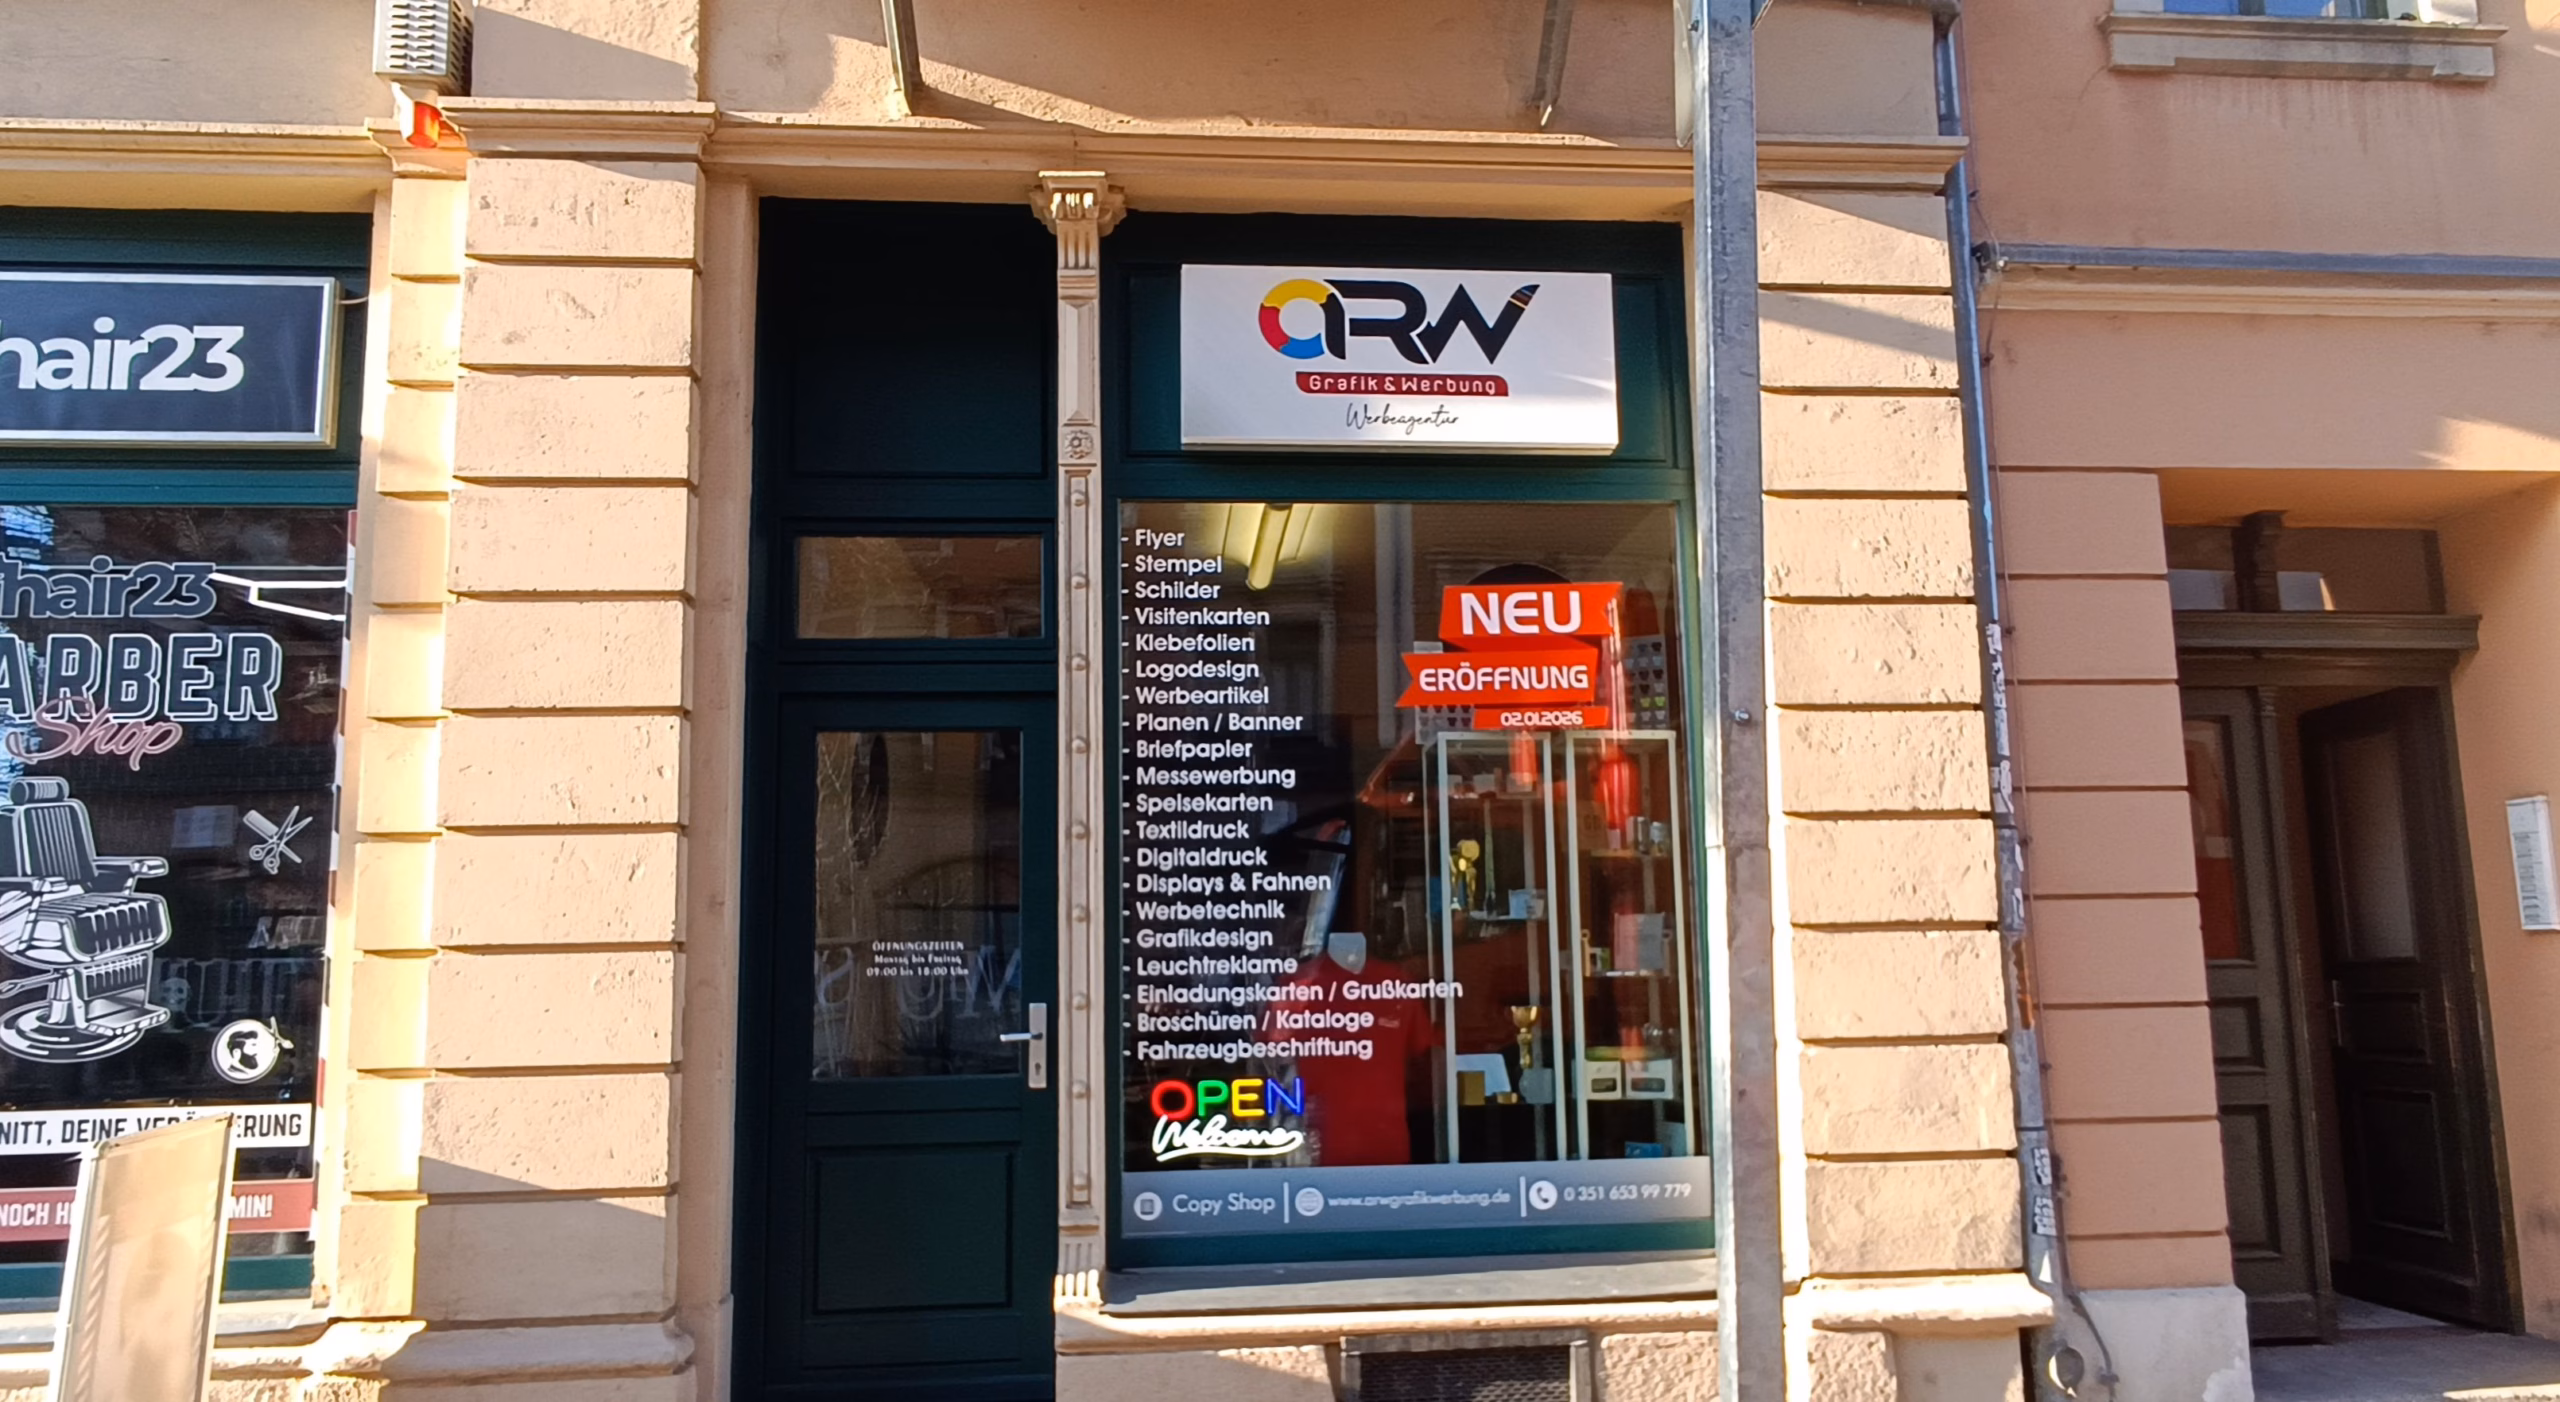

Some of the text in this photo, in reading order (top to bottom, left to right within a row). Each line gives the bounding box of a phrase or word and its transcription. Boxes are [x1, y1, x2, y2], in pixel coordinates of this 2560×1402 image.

[1346, 402, 1459, 435] Werbeagentur
[1135, 528, 1185, 550] Flyer
[1134, 554, 1222, 576] Stempel
[1135, 580, 1221, 599] Schilder
[1134, 607, 1270, 626] Visitenkarten
[1460, 590, 1582, 635] NEU
[1136, 633, 1255, 652] Klebefolien
[1136, 659, 1260, 683] Logodesign
[1418, 661, 1589, 692] ERÖFFNUNG
[1135, 685, 1269, 705] Werbeartikel
[1136, 712, 1304, 733] Planen / Banner
[1500, 711, 1583, 727] 02.01.2026
[5, 696, 183, 771] Shop
[1136, 739, 1253, 762] Briefpapier
[1136, 765, 1296, 789] Messewerbung
[1136, 792, 1274, 816] Speisekarten
[1136, 819, 1250, 840] Textildruck
[1136, 846, 1269, 871] Digitaldruck
[1137, 871, 1332, 897] Displays & Fahnen
[1135, 899, 1286, 921] Werbetechnik
[1136, 927, 1273, 952] Grafikdesign
[1137, 955, 1298, 976] Leuchtreklame
[1136, 980, 1464, 1007] Einladungskarten / Grußkarten
[1137, 1009, 1375, 1033] Broschüren / Kataloge
[1137, 1037, 1373, 1063] Fahrzeugbeschriftung
[1150, 1077, 1305, 1121] OPEN
[1152, 1115, 1304, 1162] Welcome
[1578, 1185, 1605, 1201] 351
[1609, 1184, 1638, 1200] 653
[1664, 1182, 1692, 1198] 779
[1172, 1192, 1276, 1216] Copy Shop
